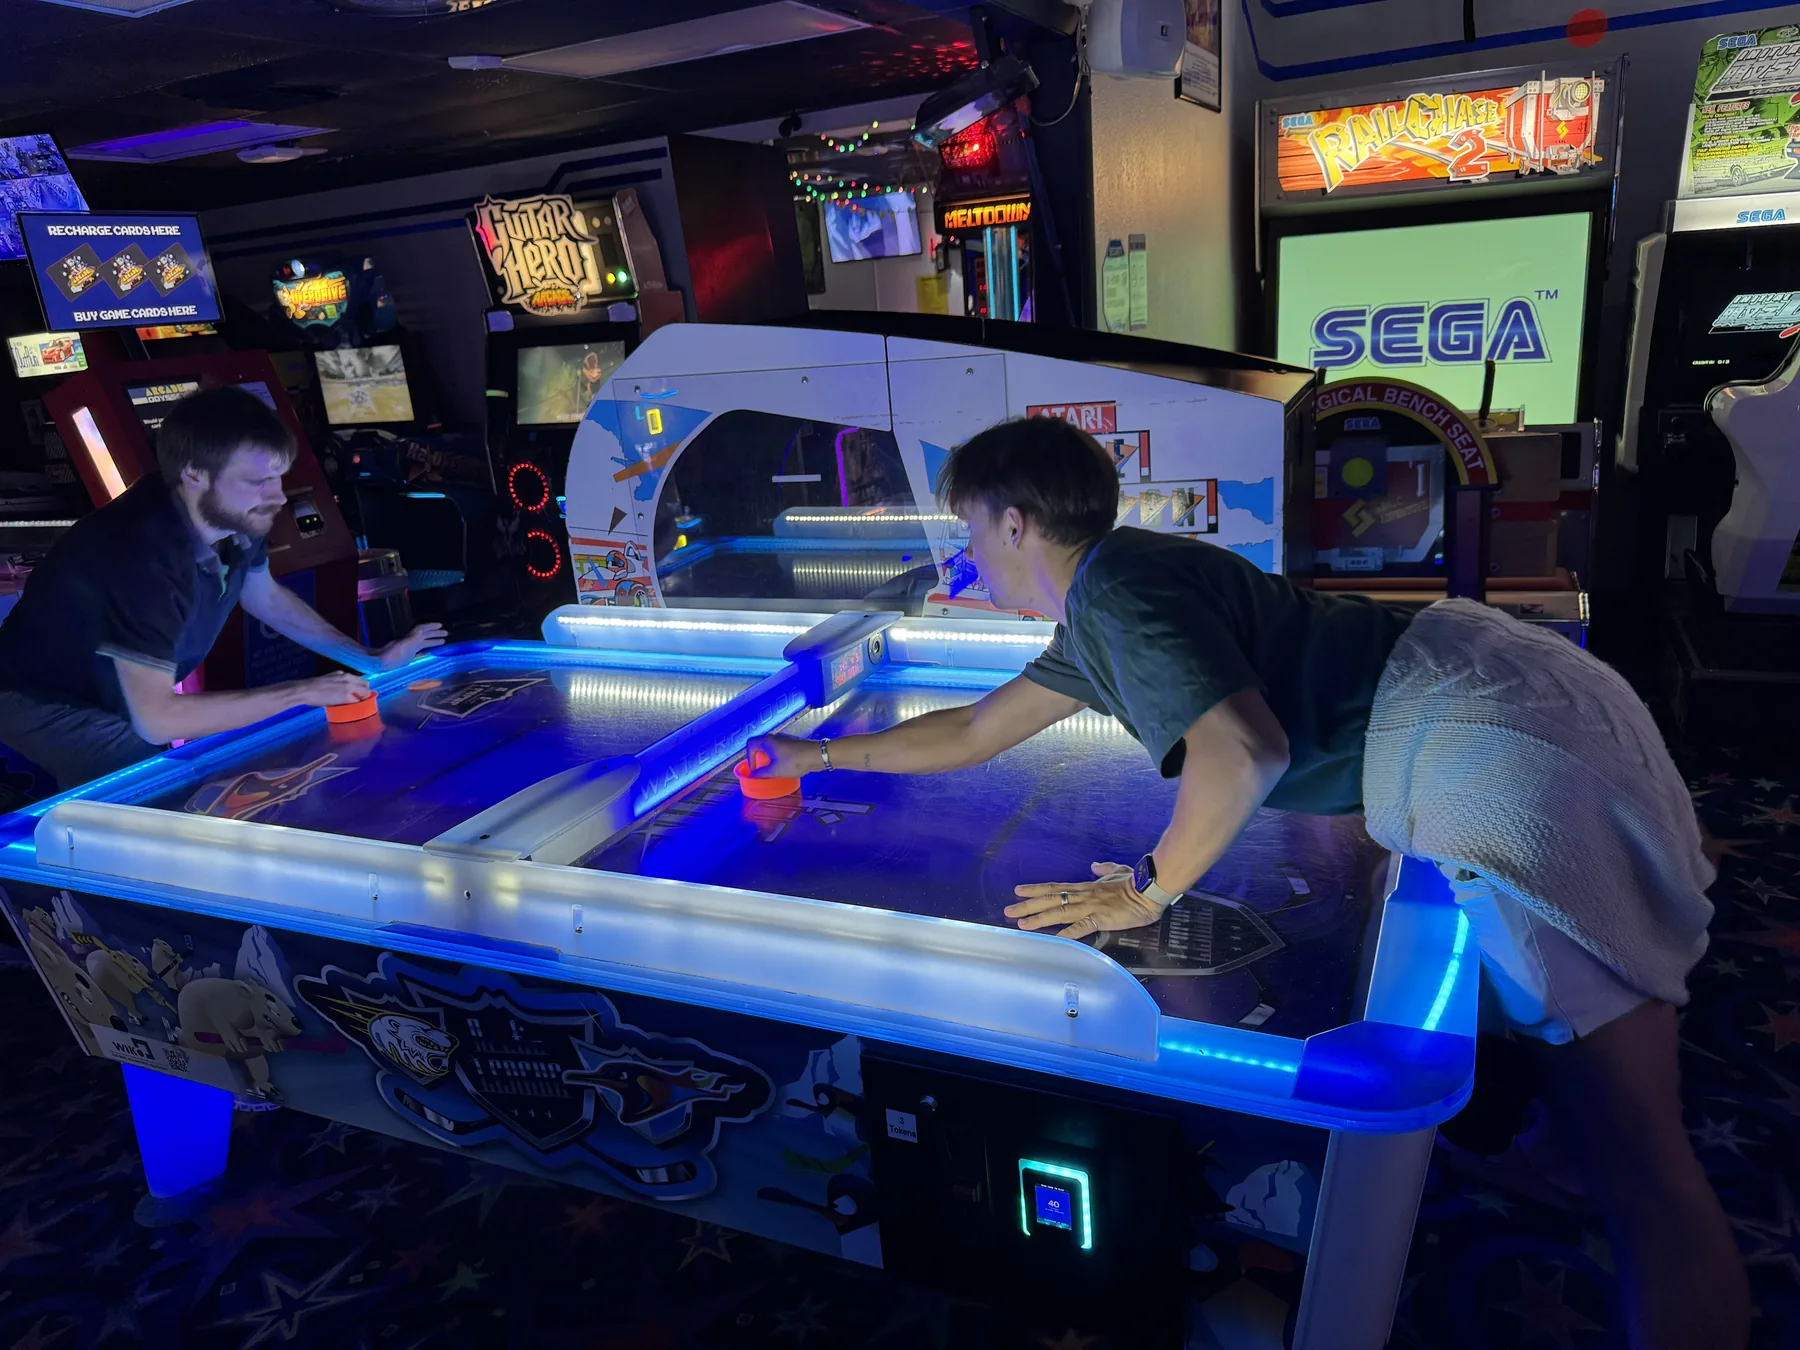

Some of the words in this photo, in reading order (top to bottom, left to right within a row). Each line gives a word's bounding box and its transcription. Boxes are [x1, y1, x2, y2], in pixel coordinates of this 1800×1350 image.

[1717, 34, 1757, 50] SEGA
[1282, 113, 1313, 128] SEGA
[1309, 108, 1402, 192] RAIL
[1404, 93, 1499, 143] CHASE
[1447, 127, 1491, 181] 2
[944, 202, 1031, 229] MELTDOWN
[1736, 209, 1786, 223] SEGA
[48, 225, 112, 236] RECHARGE
[113, 225, 150, 236] CARDS
[150, 225, 181, 235] HERE
[476, 196, 598, 254] GUITAR
[504, 236, 588, 297] HERO
[530, 289, 579, 307] ARCADE
[1534, 289, 1559, 301] TM
[74, 311, 99, 322] BUY
[99, 309, 131, 320] GAME
[131, 307, 168, 318] CARDS
[168, 305, 198, 315] HERE
[1310, 297, 1553, 372] SEGA
[146, 384, 184, 397] ARCADE
[1316, 386, 1377, 412] GICAL
[1384, 387, 1450, 428] BENCH
[1446, 423, 1484, 471] SEAT
[640, 686, 806, 800] WATERPROOF
[899, 1116, 905, 1125] 3
[889, 1124, 916, 1138] Tokens
[1048, 1199, 1060, 1209] 40
